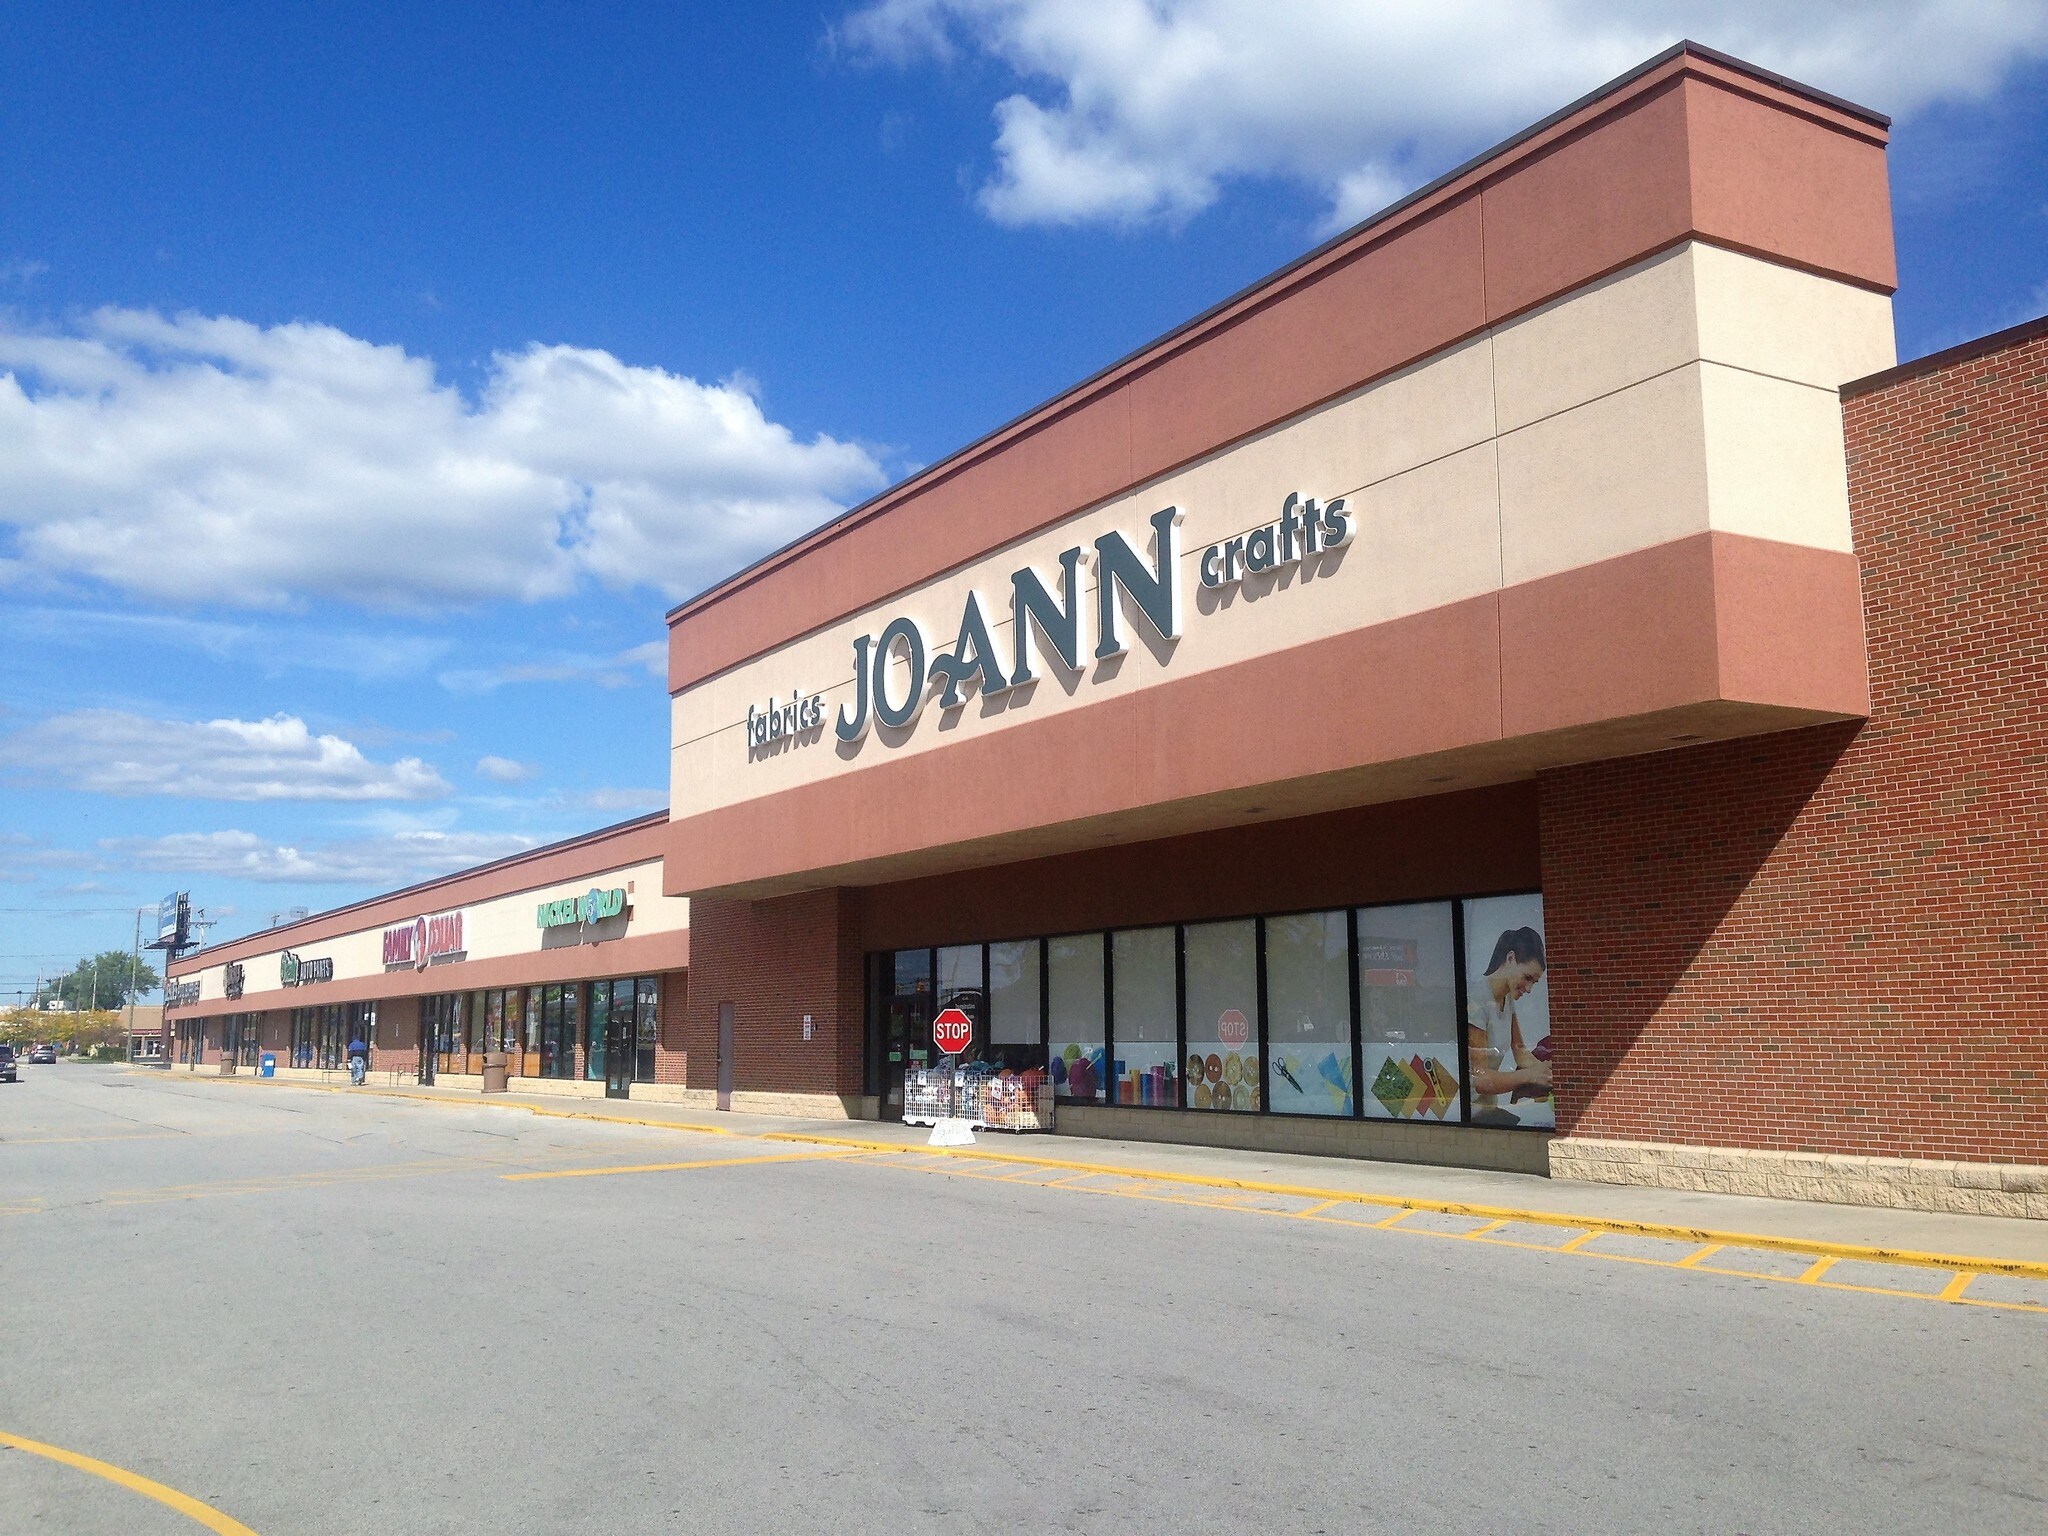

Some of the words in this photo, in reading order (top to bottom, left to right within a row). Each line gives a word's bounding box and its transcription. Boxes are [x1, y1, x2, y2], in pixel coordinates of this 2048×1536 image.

[747, 689, 823, 748] fabrics
[1200, 491, 1352, 588] crafts
[936, 1022, 969, 1040] STOP
